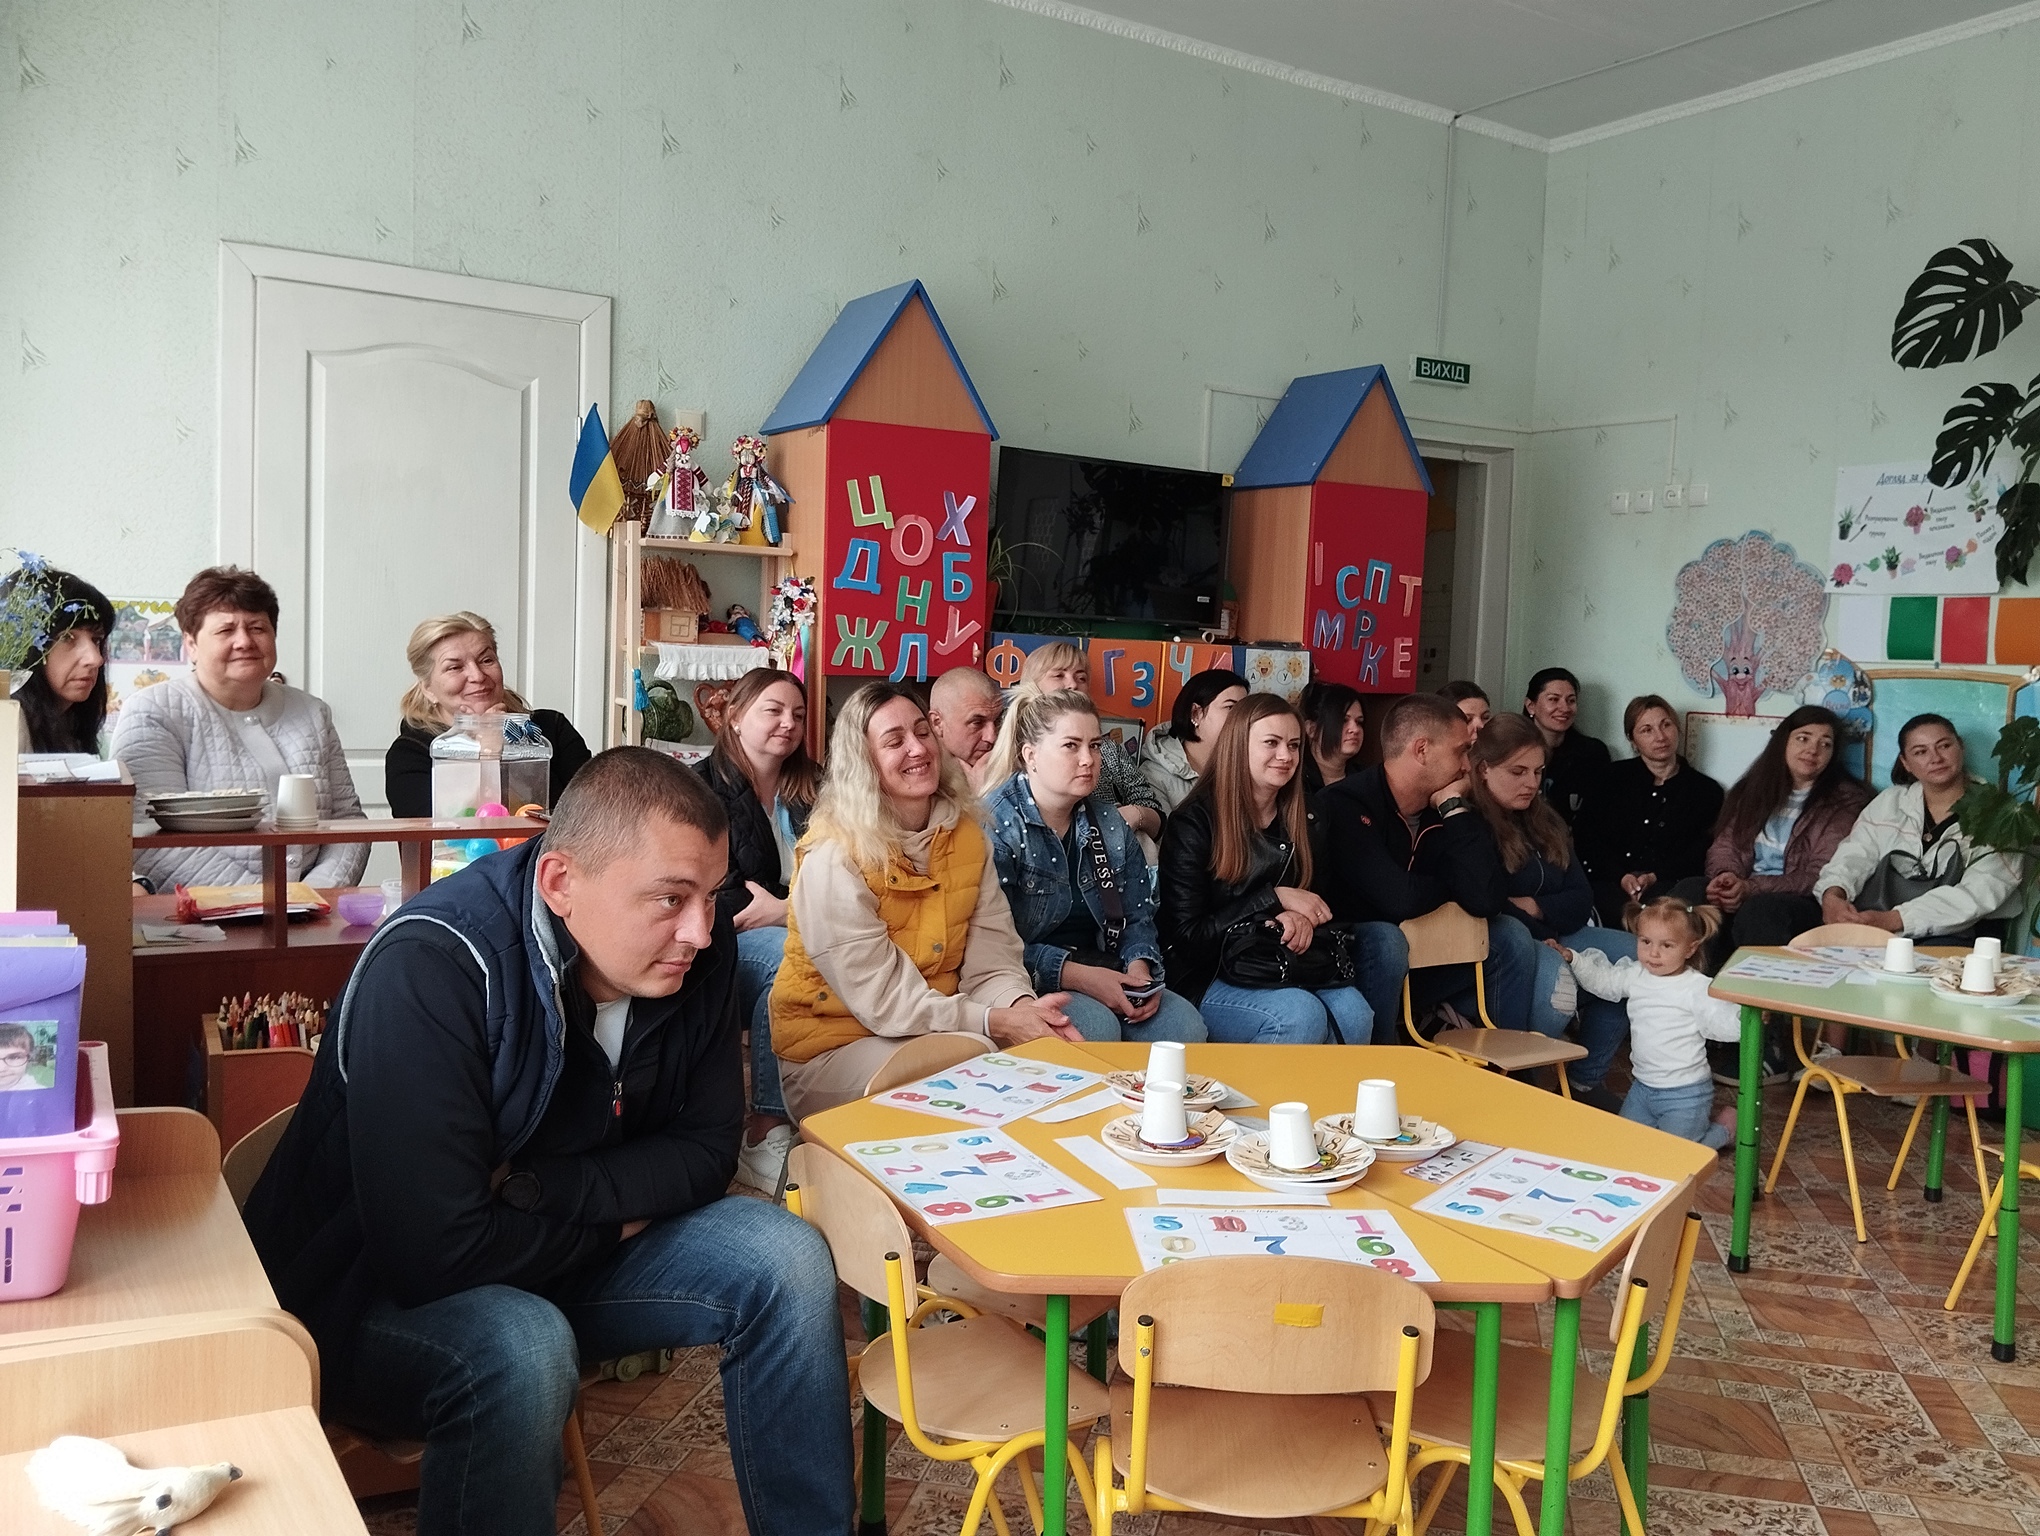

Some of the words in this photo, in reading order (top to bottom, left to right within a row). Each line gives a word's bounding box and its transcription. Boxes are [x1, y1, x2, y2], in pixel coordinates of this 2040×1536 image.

[1421, 361, 1465, 382] ВИХІД
[847, 475, 895, 529] Ц
[936, 490, 977, 546] Х
[891, 514, 933, 566] О
[833, 538, 881, 595] Д
[942, 552, 973, 602] Б
[1314, 542, 1323, 586] І
[1363, 558, 1392, 604] П
[896, 576, 932, 626] Н
[1336, 566, 1360, 609] С
[1399, 575, 1422, 617] Т
[831, 614, 889, 670] Ж
[934, 605, 982, 656] У
[1313, 609, 1346, 651] М
[1352, 609, 1377, 649] Р
[889, 633, 928, 683] Л
[986, 639, 1027, 688] Ф
[1103, 648, 1125, 696] Г
[1358, 640, 1387, 686] К
[1392, 637, 1413, 678] Е
[1089, 826, 1114, 890] GUESS
[1153, 1215, 1183, 1231] 5
[1208, 1216, 1247, 1232] 10
[1254, 1236, 1288, 1255] 7
[1346, 1215, 1386, 1235] 1
[1357, 1236, 1395, 1256] 6
